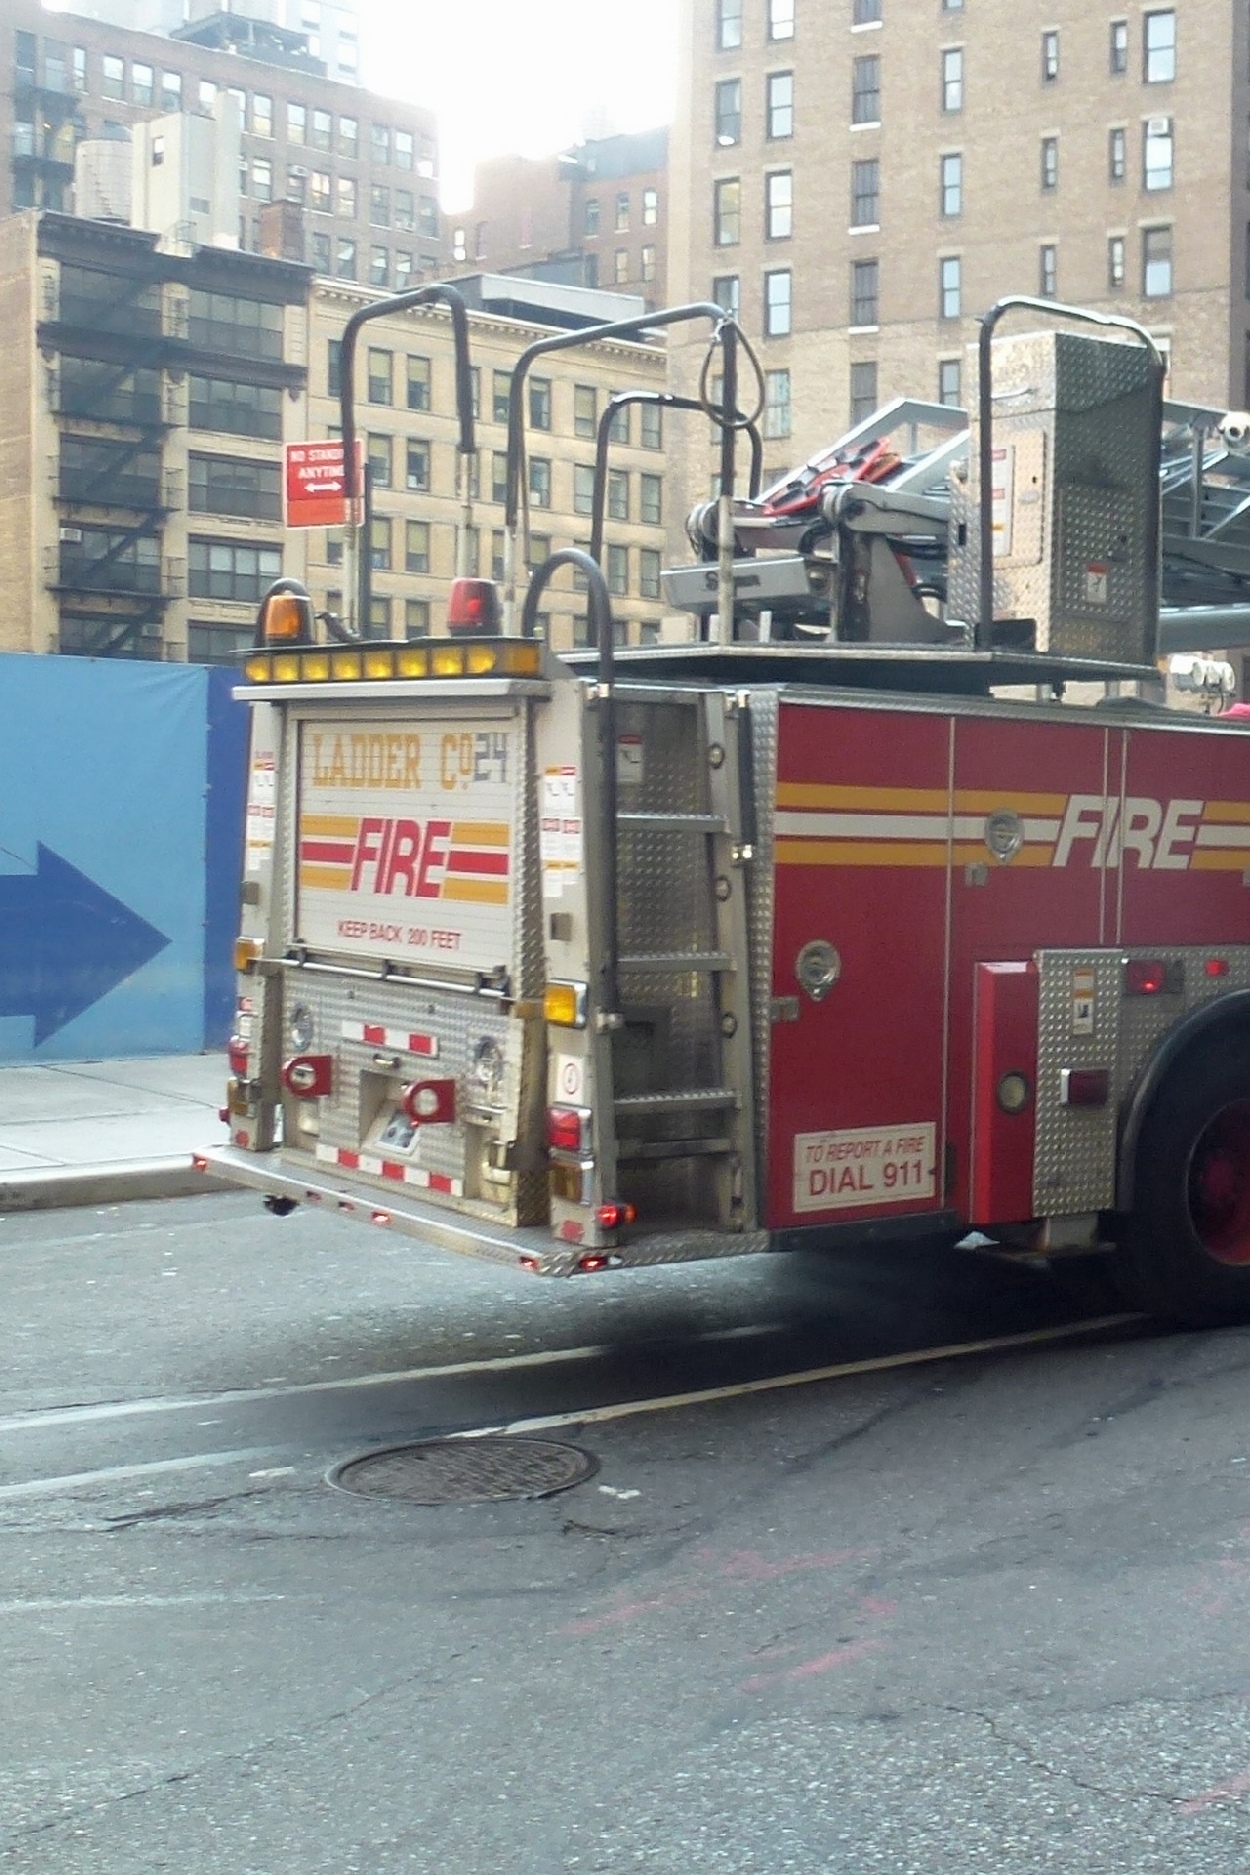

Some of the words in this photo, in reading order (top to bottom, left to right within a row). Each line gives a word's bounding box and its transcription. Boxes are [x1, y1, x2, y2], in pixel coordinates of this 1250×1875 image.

[290, 450, 305, 462] NO
[313, 733, 421, 789] LADDER
[473, 732, 507, 783] 24
[1052, 794, 1205, 870] FIRE
[351, 818, 452, 898] FIRE
[338, 920, 367, 938] KEEP
[369, 922, 402, 942] BACK
[408, 927, 428, 946] 200
[430, 929, 462, 949] FEET
[806, 1144, 823, 1164] TO
[827, 1140, 881, 1161] REPORT
[882, 1140, 893, 1157] A
[897, 1136, 925, 1153] FIRE
[809, 1164, 873, 1196] DIAL
[883, 1160, 923, 1188] 911
